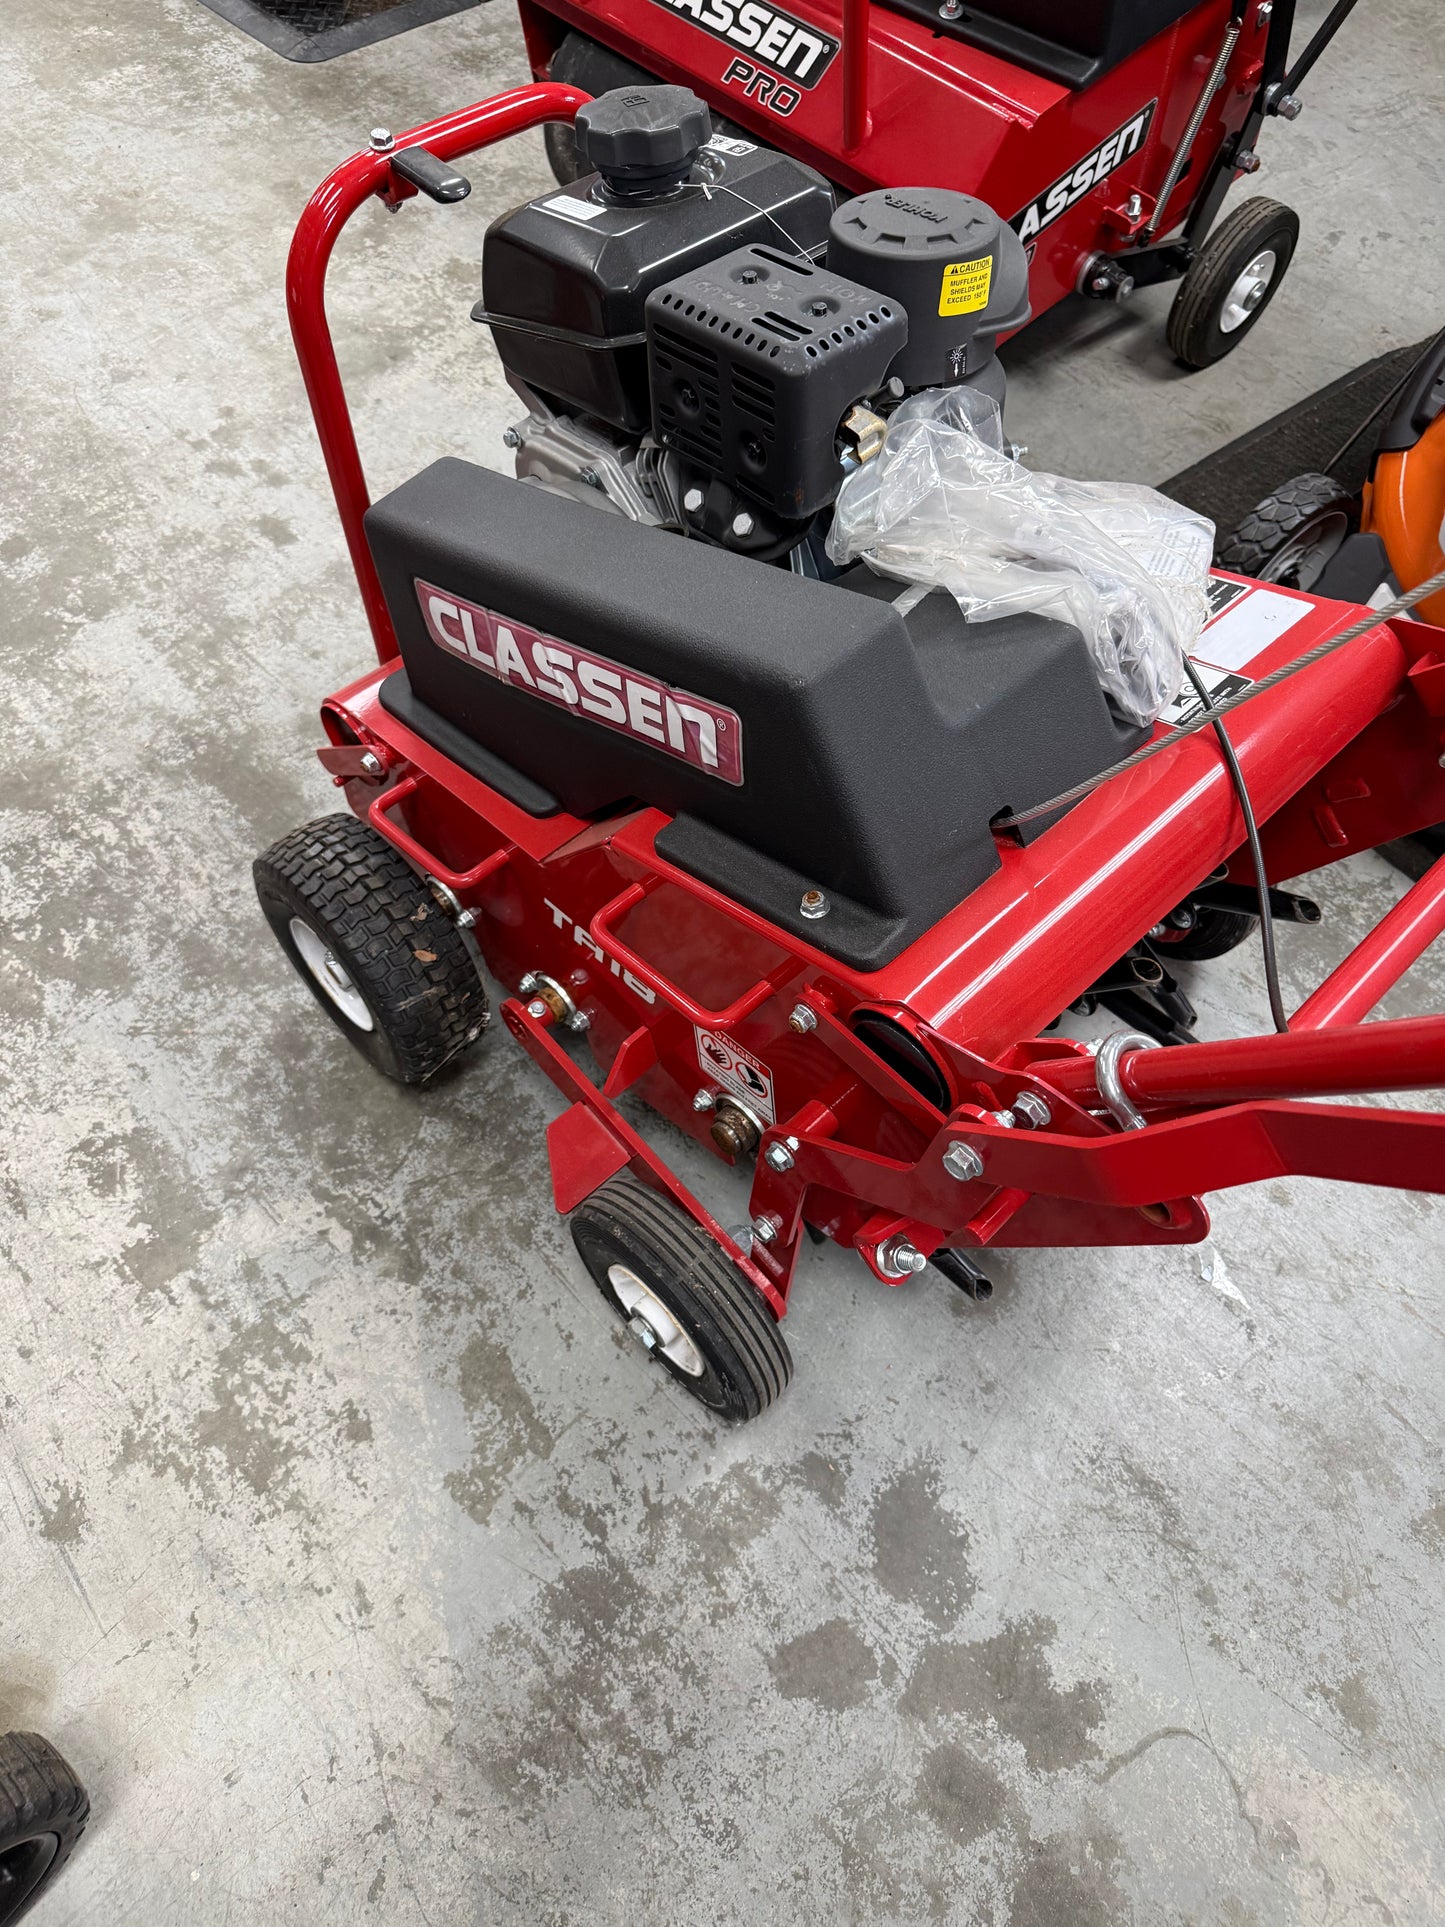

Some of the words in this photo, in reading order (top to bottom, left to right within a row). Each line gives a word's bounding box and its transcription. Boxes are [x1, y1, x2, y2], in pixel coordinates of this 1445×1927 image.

[665, 0, 825, 79] ASSEN
[721, 57, 801, 117] PRO
[959, 259, 990, 273] CAUTION
[950, 276, 977, 287] MUFFLER
[978, 273, 988, 281] AND
[950, 285, 975, 295] SHIELDS
[947, 294, 971, 304] EXCEED
[428, 595, 719, 769] CLASSEN
[714, 1031, 761, 1071] DANGER
